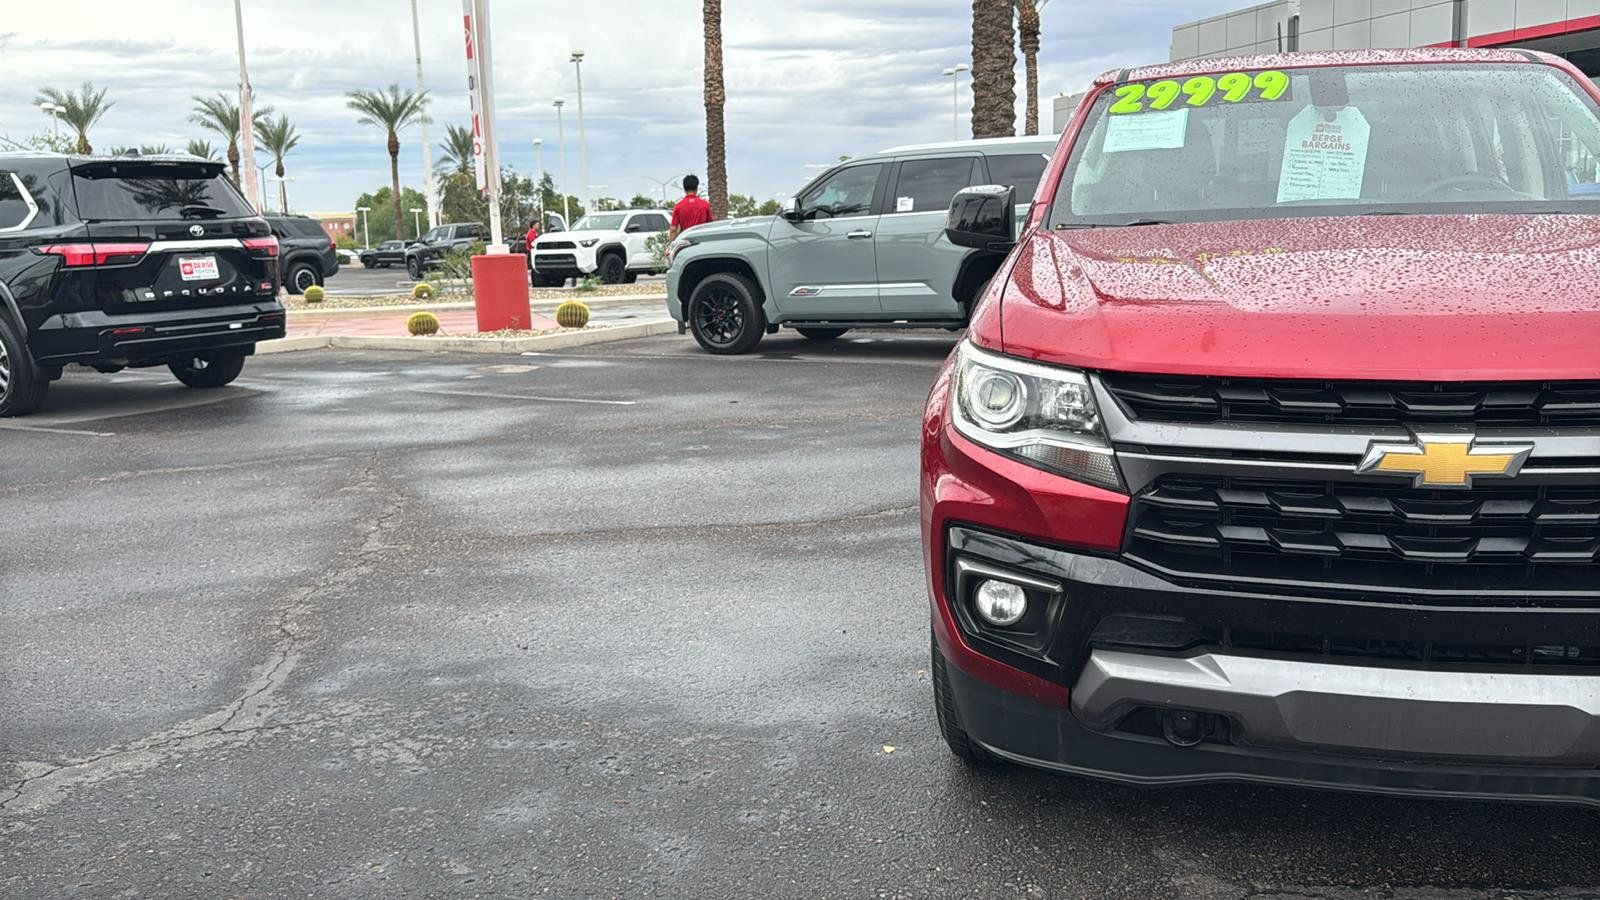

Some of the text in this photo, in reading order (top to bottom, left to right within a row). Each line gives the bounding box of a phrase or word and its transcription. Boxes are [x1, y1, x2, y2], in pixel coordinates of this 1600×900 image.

[1108, 71, 1290, 114] 29999
[1312, 134, 1343, 143] BERGE
[1302, 140, 1351, 151] BARGAINS
